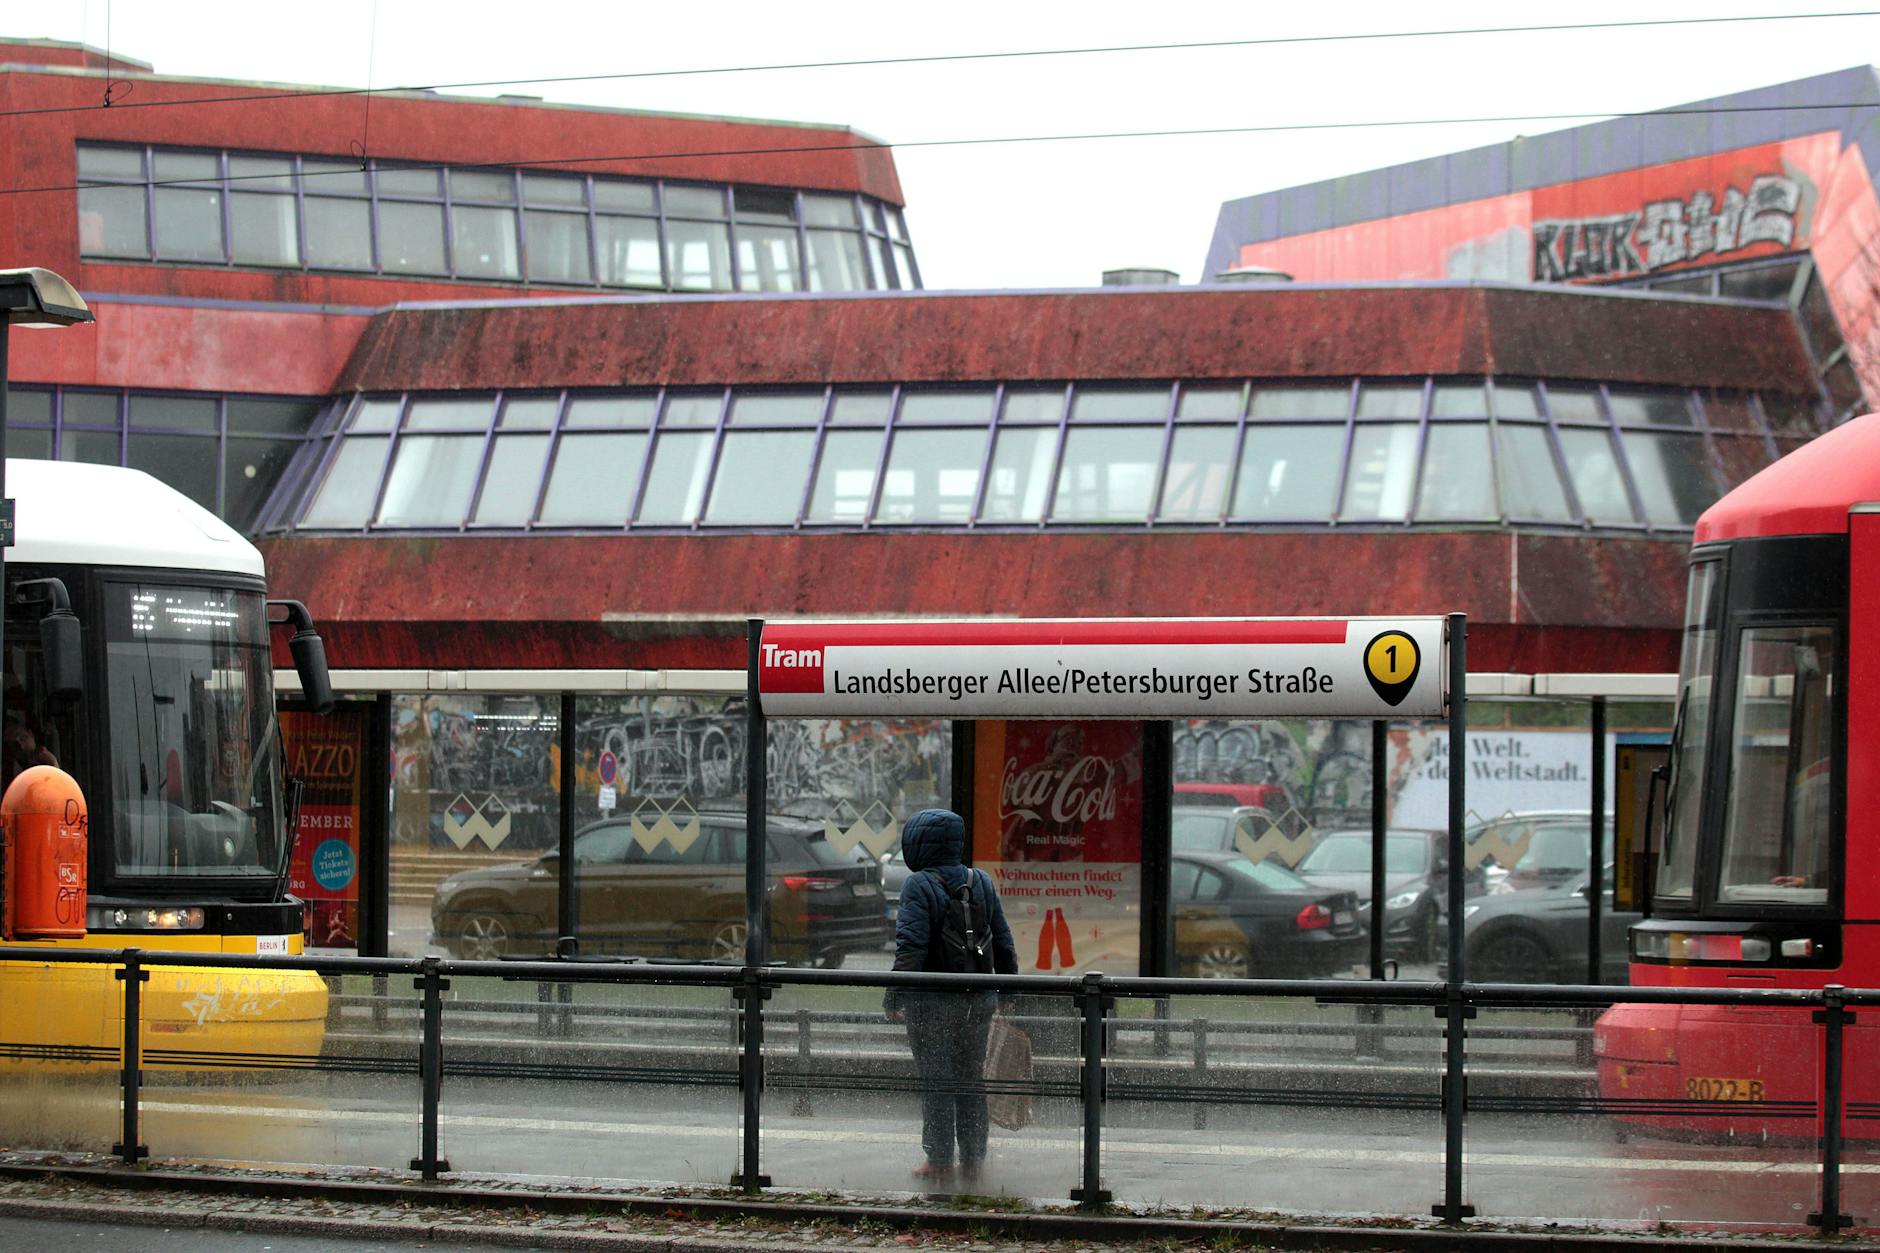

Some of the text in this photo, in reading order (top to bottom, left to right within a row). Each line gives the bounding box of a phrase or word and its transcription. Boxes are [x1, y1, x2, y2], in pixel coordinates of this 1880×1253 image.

[762, 644, 822, 668] Tram
[1385, 645, 1397, 673] 1
[835, 661, 1334, 700] Landsberger Allee/Petersburger Straße
[1472, 737, 1530, 758] Welt.
[1472, 761, 1587, 782] Weltstadt.
[999, 756, 1116, 823] Coca-Cola
[1027, 835, 1086, 847] Real Magic
[61, 867, 77, 883] BSR
[994, 869, 1122, 882] Weihnachten findet
[1000, 886, 1116, 900] immer einen Weg.
[259, 942, 278, 950] BERLIN
